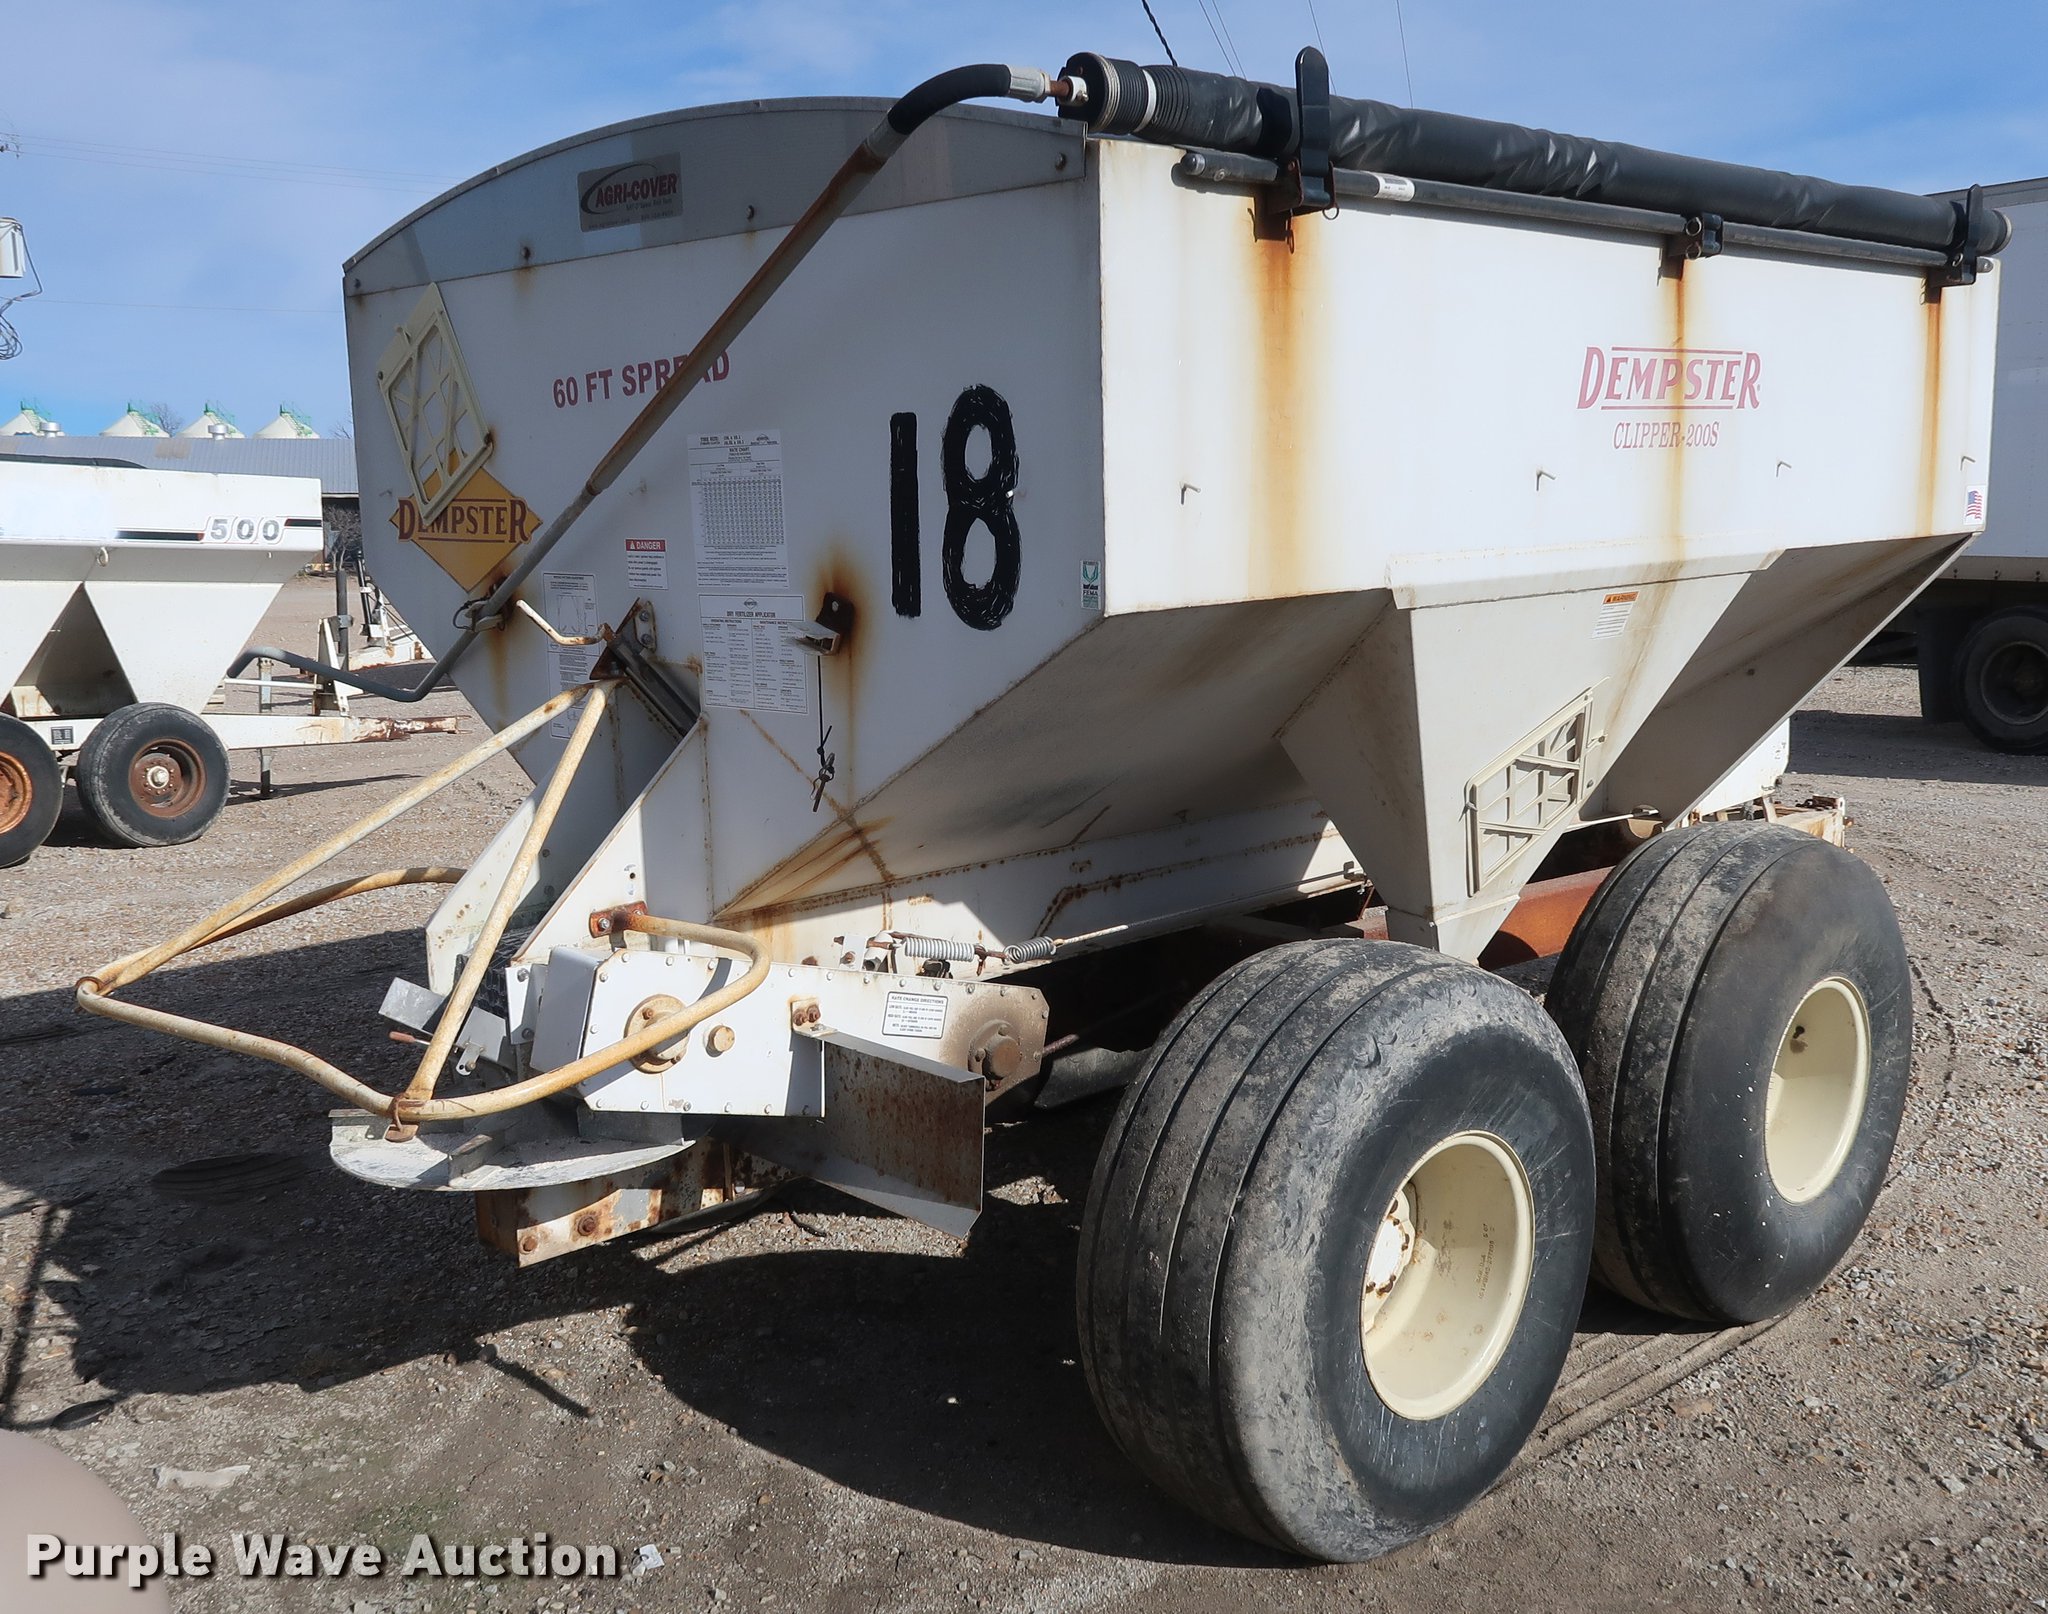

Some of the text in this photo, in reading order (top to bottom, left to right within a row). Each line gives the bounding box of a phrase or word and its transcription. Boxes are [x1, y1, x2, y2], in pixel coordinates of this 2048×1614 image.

[595, 173, 678, 208] AGRI-COVER
[553, 350, 730, 409] 60 FT SPRD
[1576, 346, 1762, 410] DEMPSTER
[210, 518, 281, 541] 500
[890, 383, 1022, 631] 18
[636, 541, 661, 550] DANGER
